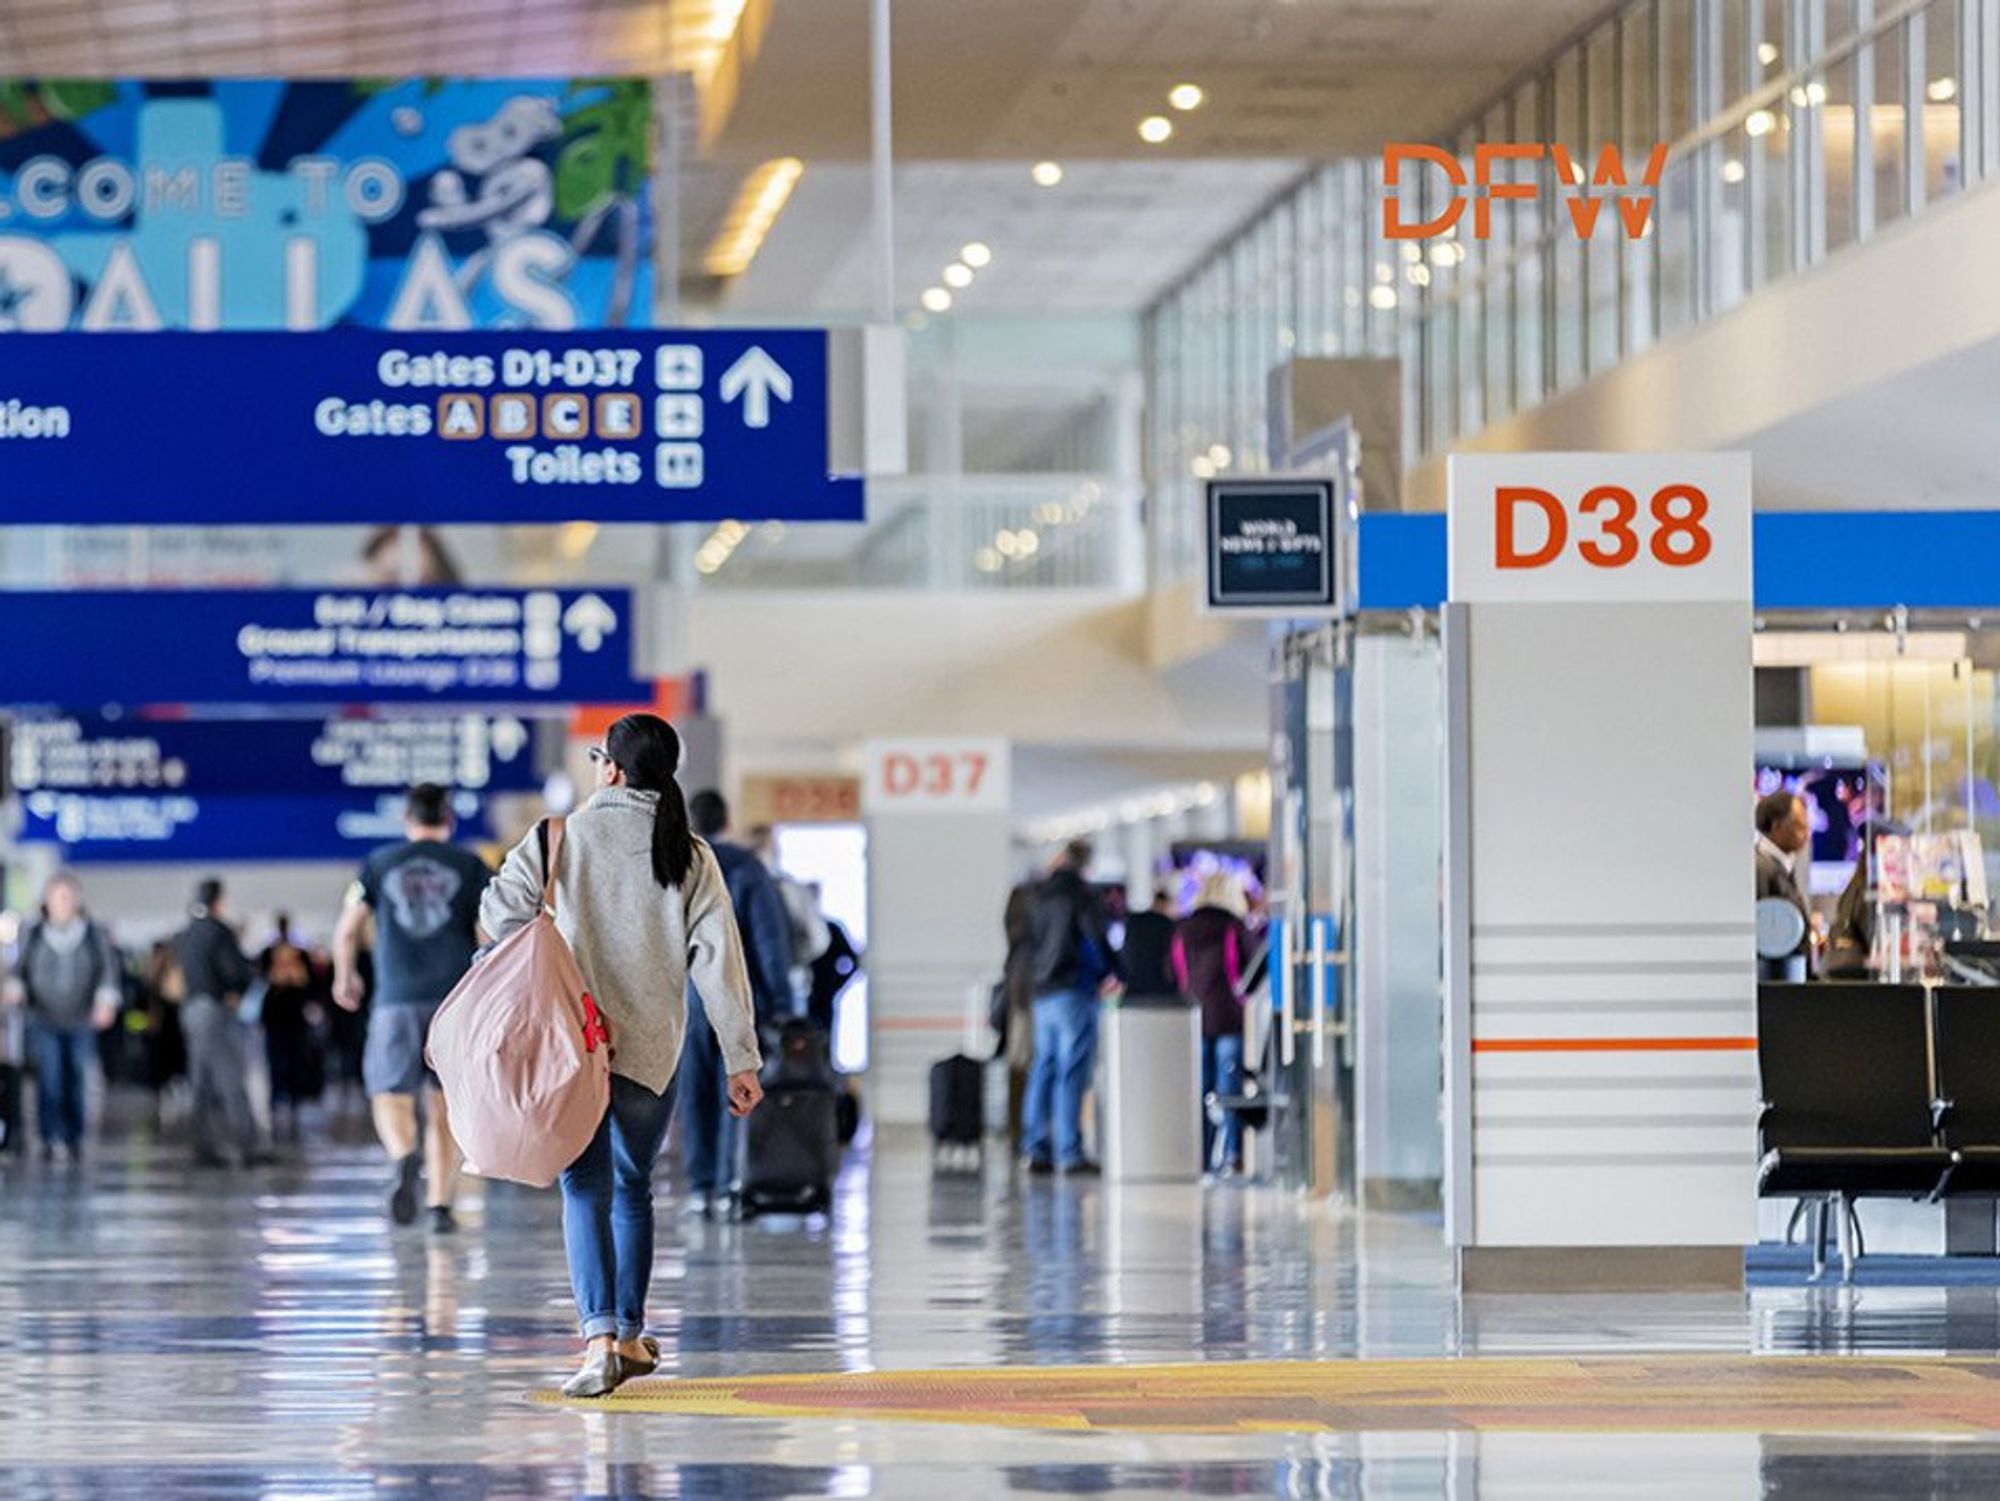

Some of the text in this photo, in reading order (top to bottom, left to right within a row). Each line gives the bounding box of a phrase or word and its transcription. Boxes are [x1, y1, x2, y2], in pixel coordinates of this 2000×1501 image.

[0, 158, 402, 220] COME TO
[378, 348, 642, 387] Gates D1-D37
[314, 397, 635, 436] Gates A B C E
[505, 445, 642, 484] Toilets
[1494, 484, 1712, 570] D38
[881, 752, 990, 798] D37
